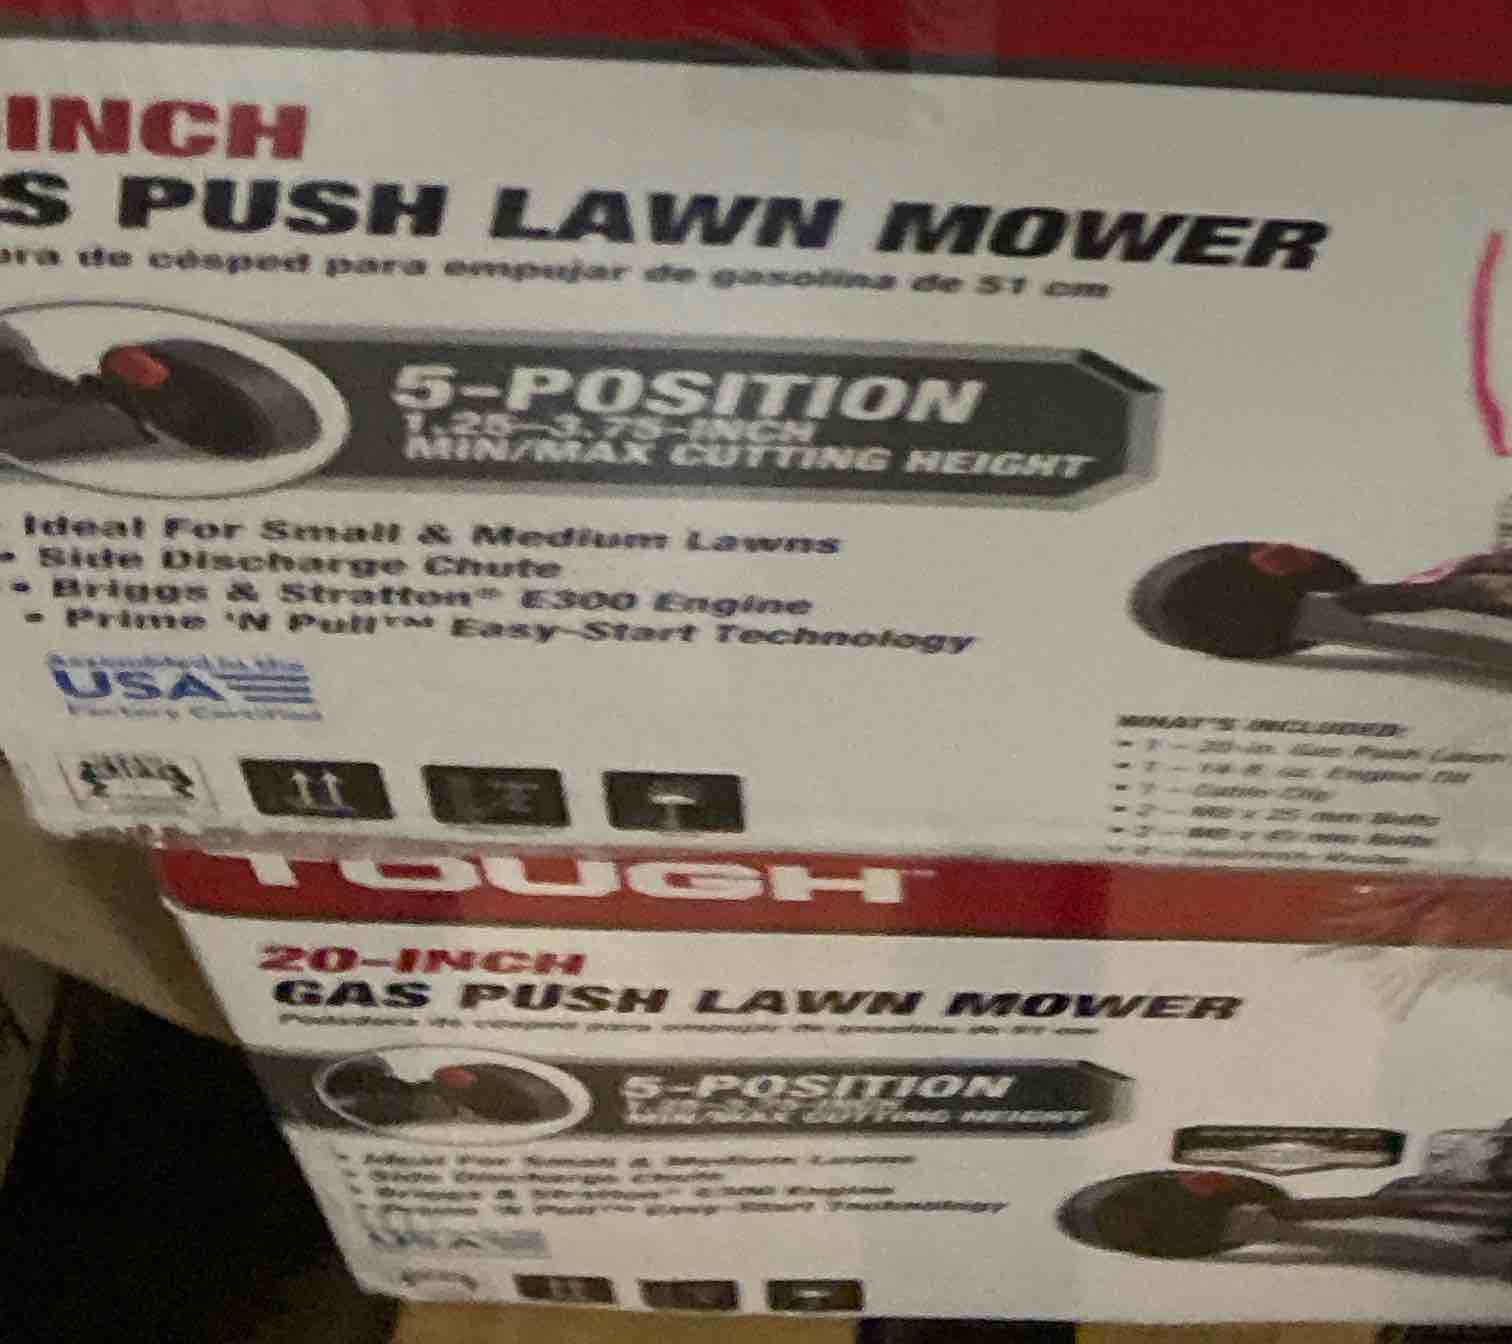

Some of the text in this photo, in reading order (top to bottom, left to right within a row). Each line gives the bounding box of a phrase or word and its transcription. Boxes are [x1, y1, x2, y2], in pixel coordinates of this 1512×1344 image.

[118, 175, 448, 237] PUSH
[490, 187, 843, 251] LAWN
[875, 200, 1332, 272] MOWER
[77, 246, 133, 270] de
[148, 246, 313, 275] césped
[324, 253, 428, 278] para
[444, 254, 633, 284] empujar
[644, 259, 699, 283] de
[710, 263, 895, 292] gasolina
[911, 268, 963, 295] de
[974, 271, 1027, 295] 51
[1043, 278, 1113, 300] cm
[389, 362, 986, 426] 5-POSITION
[402, 436, 1096, 481] MIN/MAX CUTTING HEIGHT
[23, 512, 842, 556] Ideal For Small & Medium Lawns
[38, 546, 564, 580] Side Discharge Chute
[52, 577, 209, 606] Briggs
[225, 581, 259, 603] &
[519, 587, 638, 614] E300
[652, 591, 814, 620] Engine
[64, 608, 208, 633] Prime
[450, 617, 700, 646] Easy-Start
[714, 621, 980, 655] Technology
[52, 670, 227, 702] USA
[1116, 714, 1237, 732] WHAT'S
[258, 943, 588, 976] 20-INCH
[272, 978, 1245, 1021] GAS PUSH LAWN MOWER
[621, 1073, 1018, 1100] 5-POSITION
